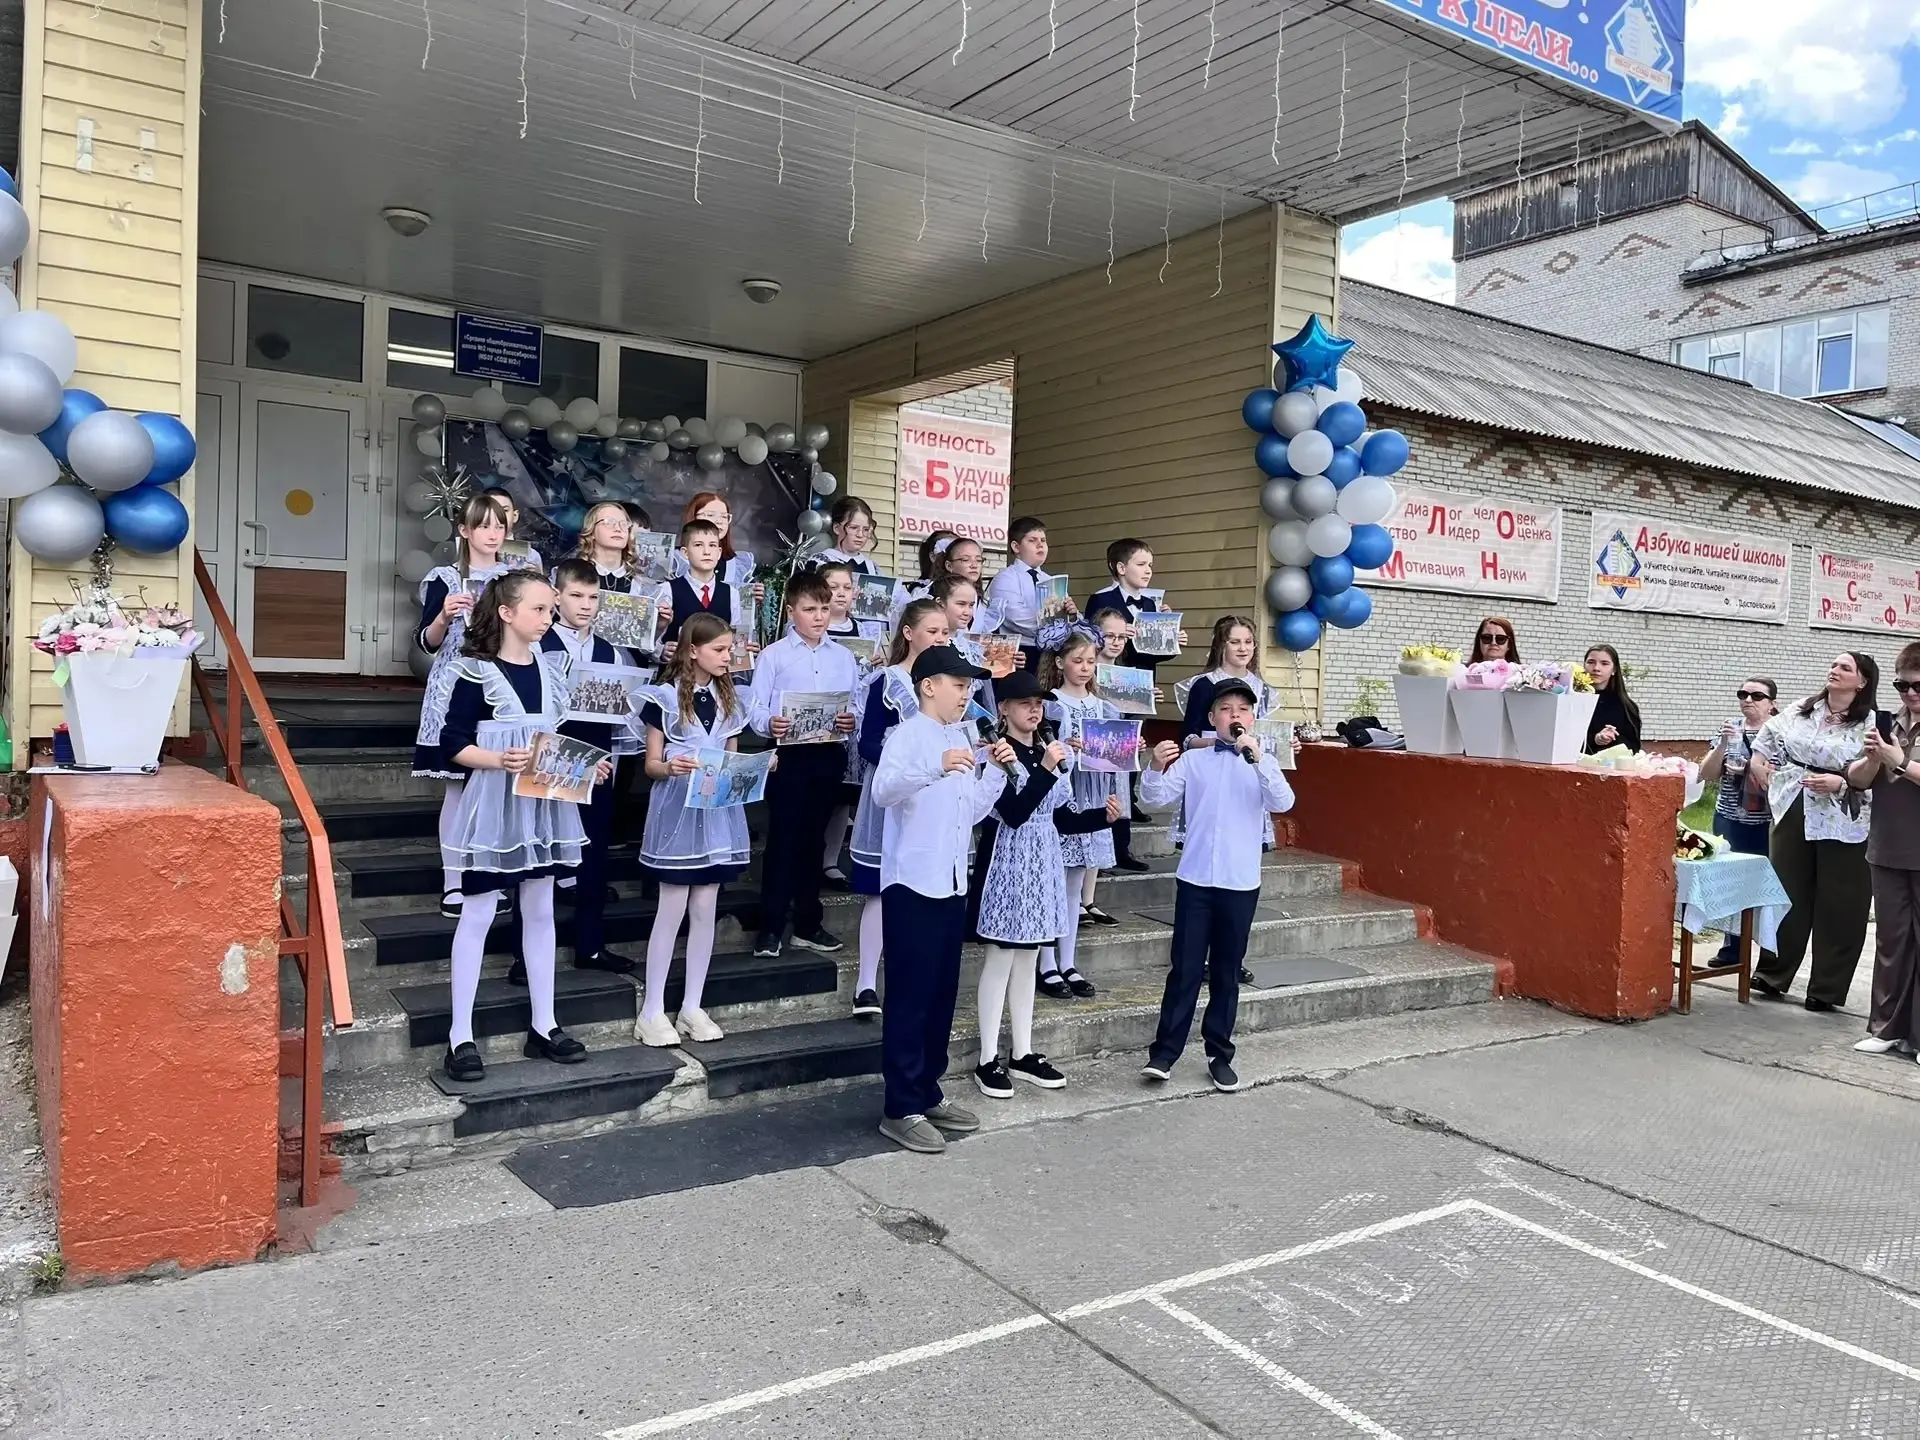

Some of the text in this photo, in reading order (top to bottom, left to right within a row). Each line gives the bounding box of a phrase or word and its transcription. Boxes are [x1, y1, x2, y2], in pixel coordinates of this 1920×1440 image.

[1474, 0, 1598, 83] ЦЕЛИ...
[1384, 525, 1417, 541] ство
[1635, 526, 1786, 567] Азбука нашей школы
[1481, 551, 1527, 583] Науки
[1643, 575, 1667, 585] Жизнь
